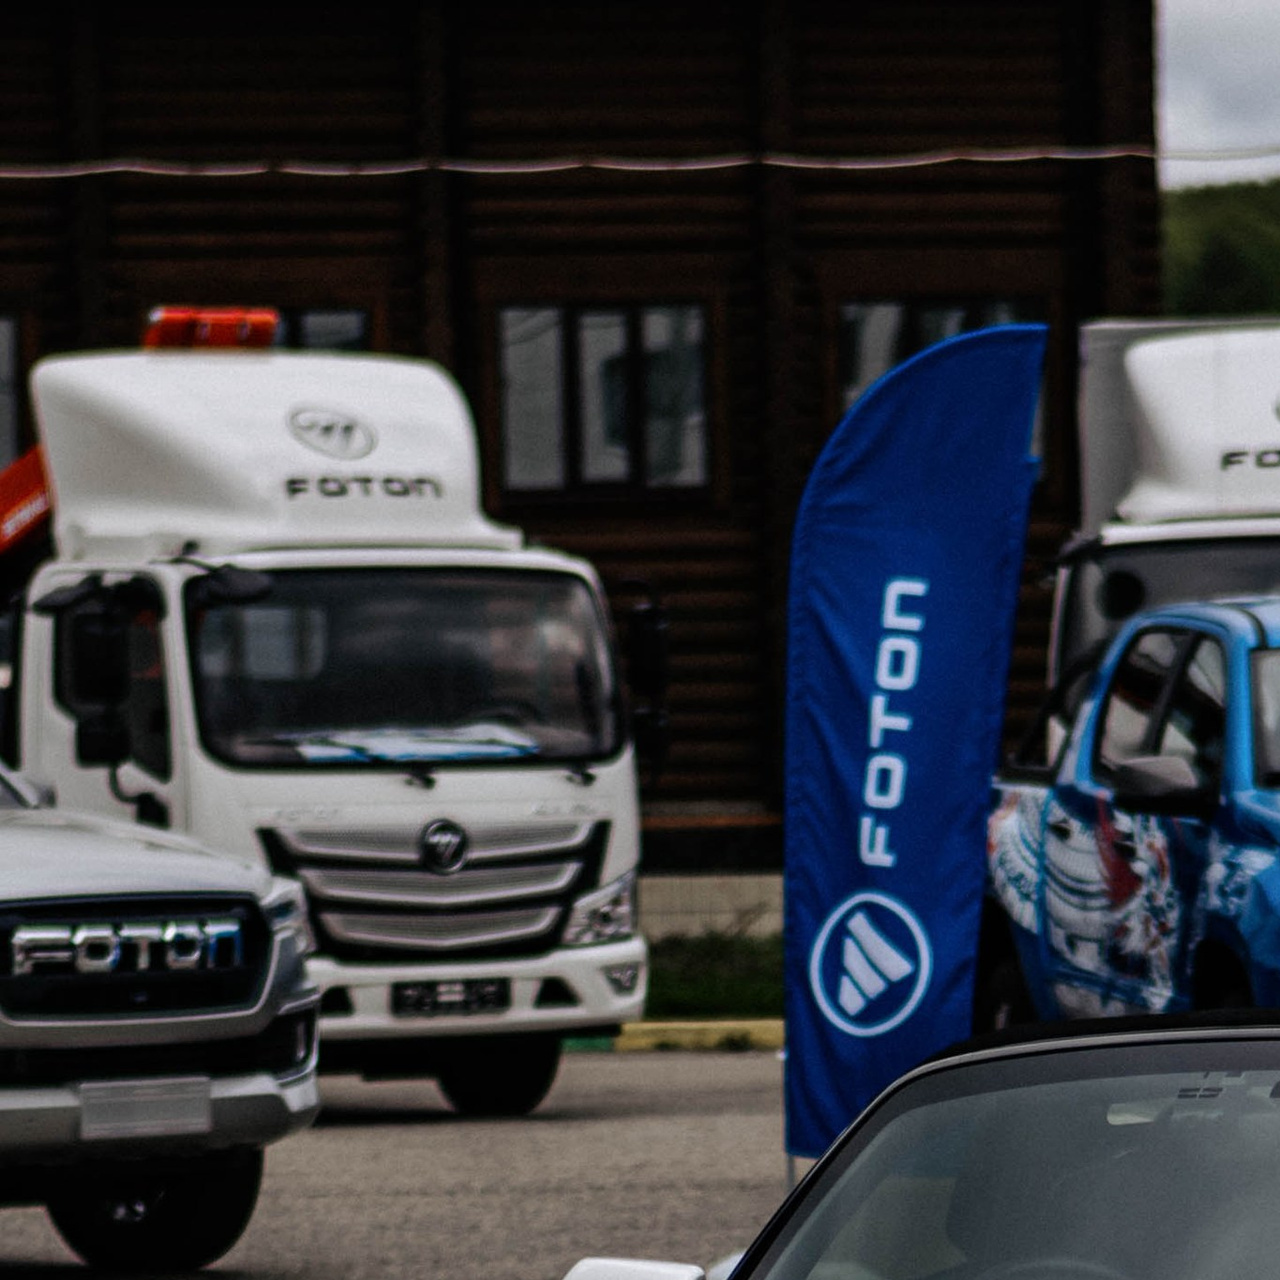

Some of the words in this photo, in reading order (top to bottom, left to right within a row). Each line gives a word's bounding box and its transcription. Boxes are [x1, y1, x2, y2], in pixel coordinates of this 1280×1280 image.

[286, 477, 443, 500] FOTON
[858, 576, 928, 868] FOTON
[11, 919, 244, 975] FOTON
